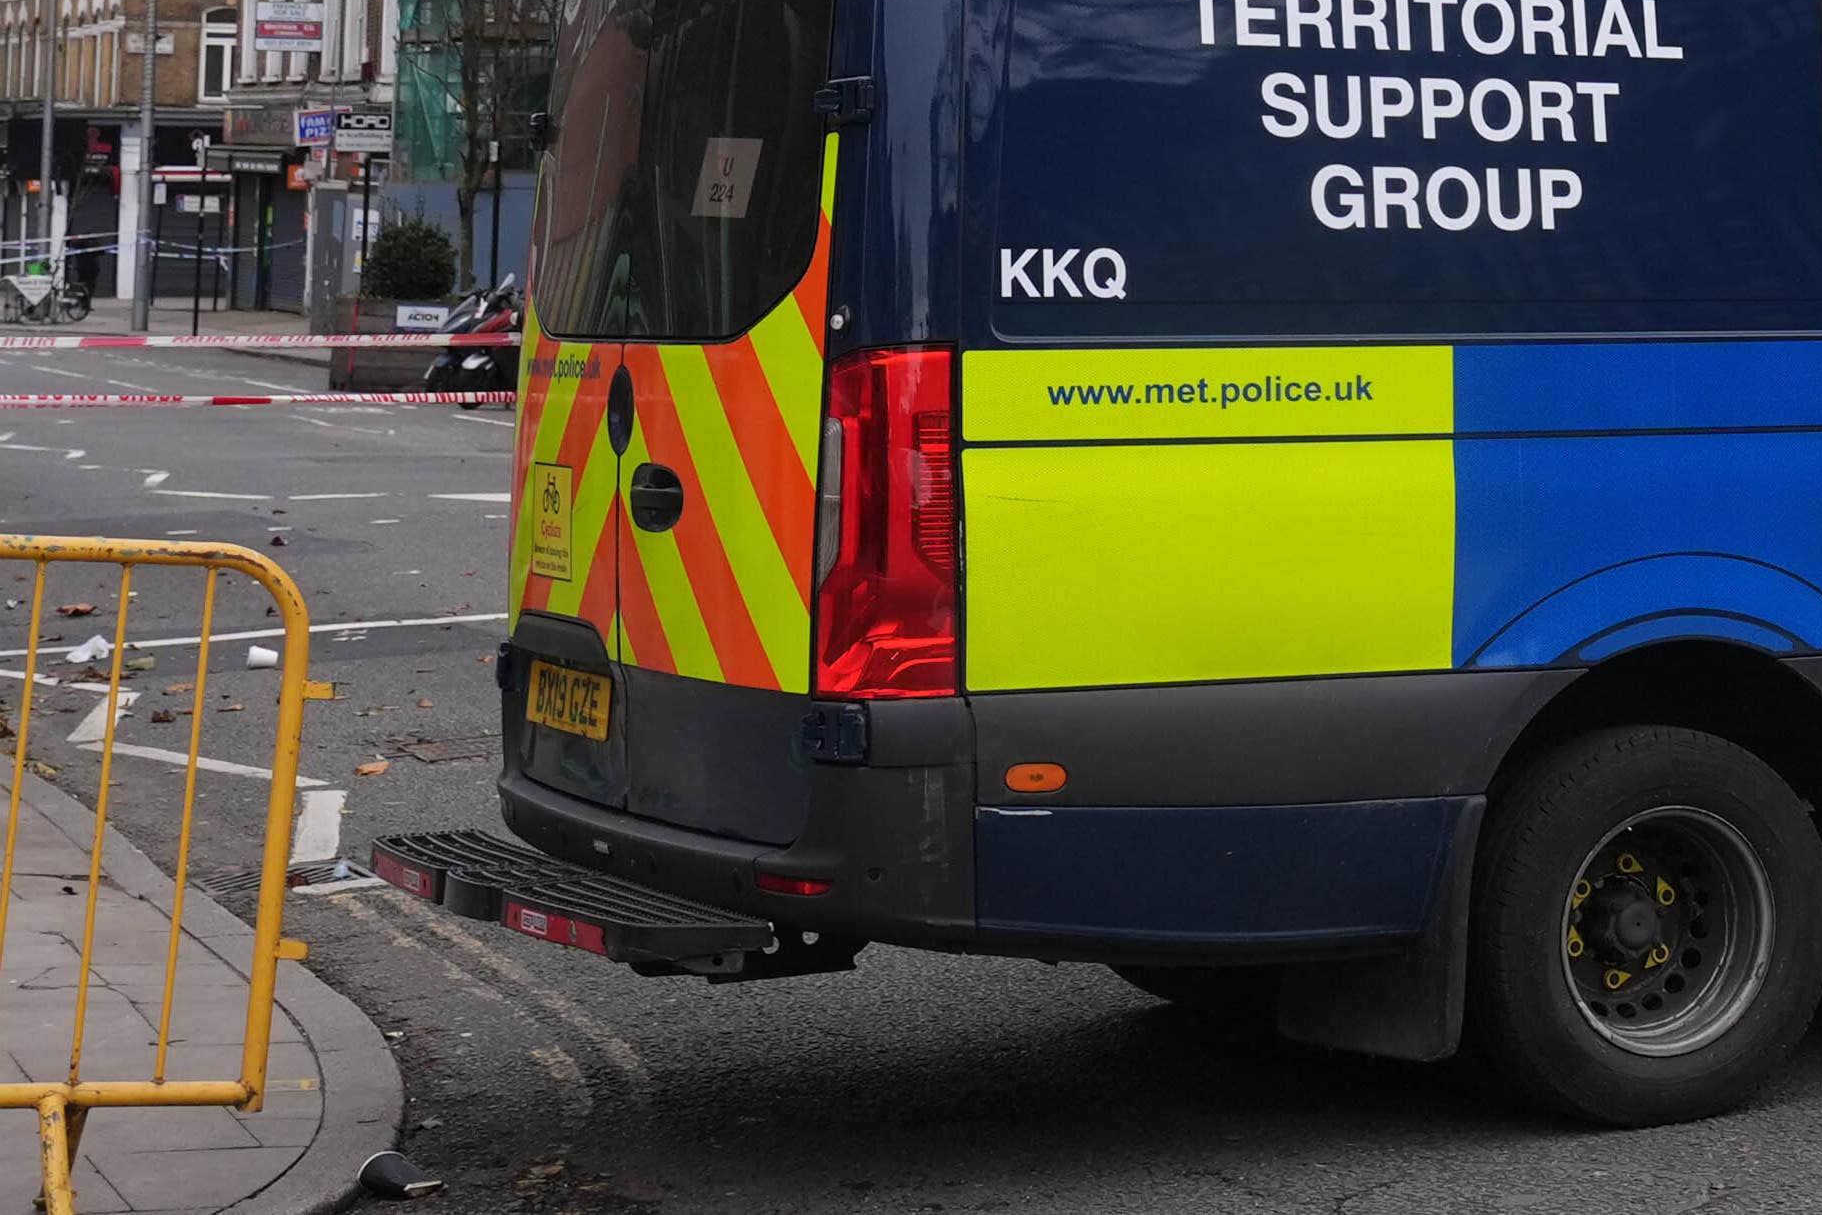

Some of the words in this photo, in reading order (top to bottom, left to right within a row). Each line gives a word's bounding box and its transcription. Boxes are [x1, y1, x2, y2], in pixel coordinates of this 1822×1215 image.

[1261, 72, 1619, 143] SUPPORT
[709, 183, 735, 202] 224
[723, 157, 735, 177] U
[1310, 163, 1582, 231] GROUP
[1000, 247, 1127, 300] KKQ
[1048, 374, 1374, 409] www.met.police.uk
[536, 669, 567, 722] BX19
[570, 676, 601, 728] GZE
